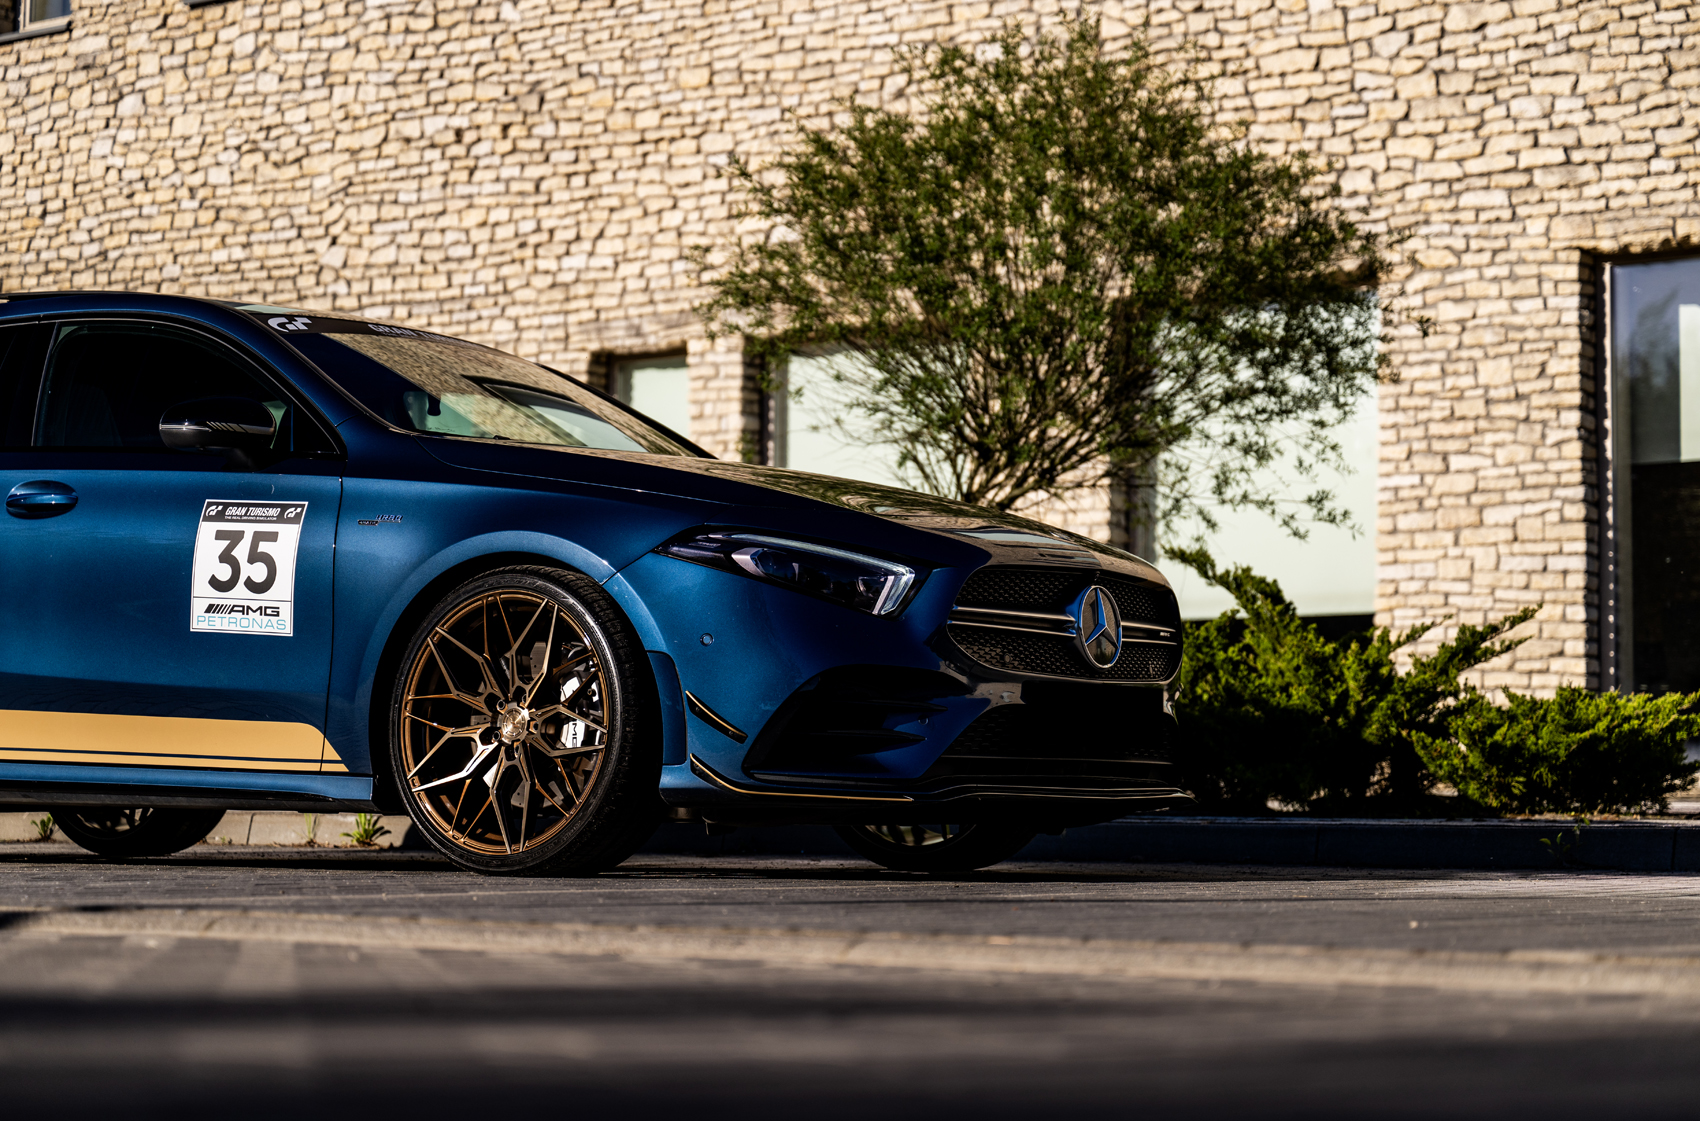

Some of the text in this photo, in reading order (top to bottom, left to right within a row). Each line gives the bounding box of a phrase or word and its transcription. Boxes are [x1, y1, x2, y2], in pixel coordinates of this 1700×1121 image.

[367, 323, 418, 337] GRAN
[225, 506, 281, 516] GRAN TURISMO
[208, 529, 279, 595] 35
[226, 604, 280, 617] AMG
[196, 615, 287, 630] PETRONAS
